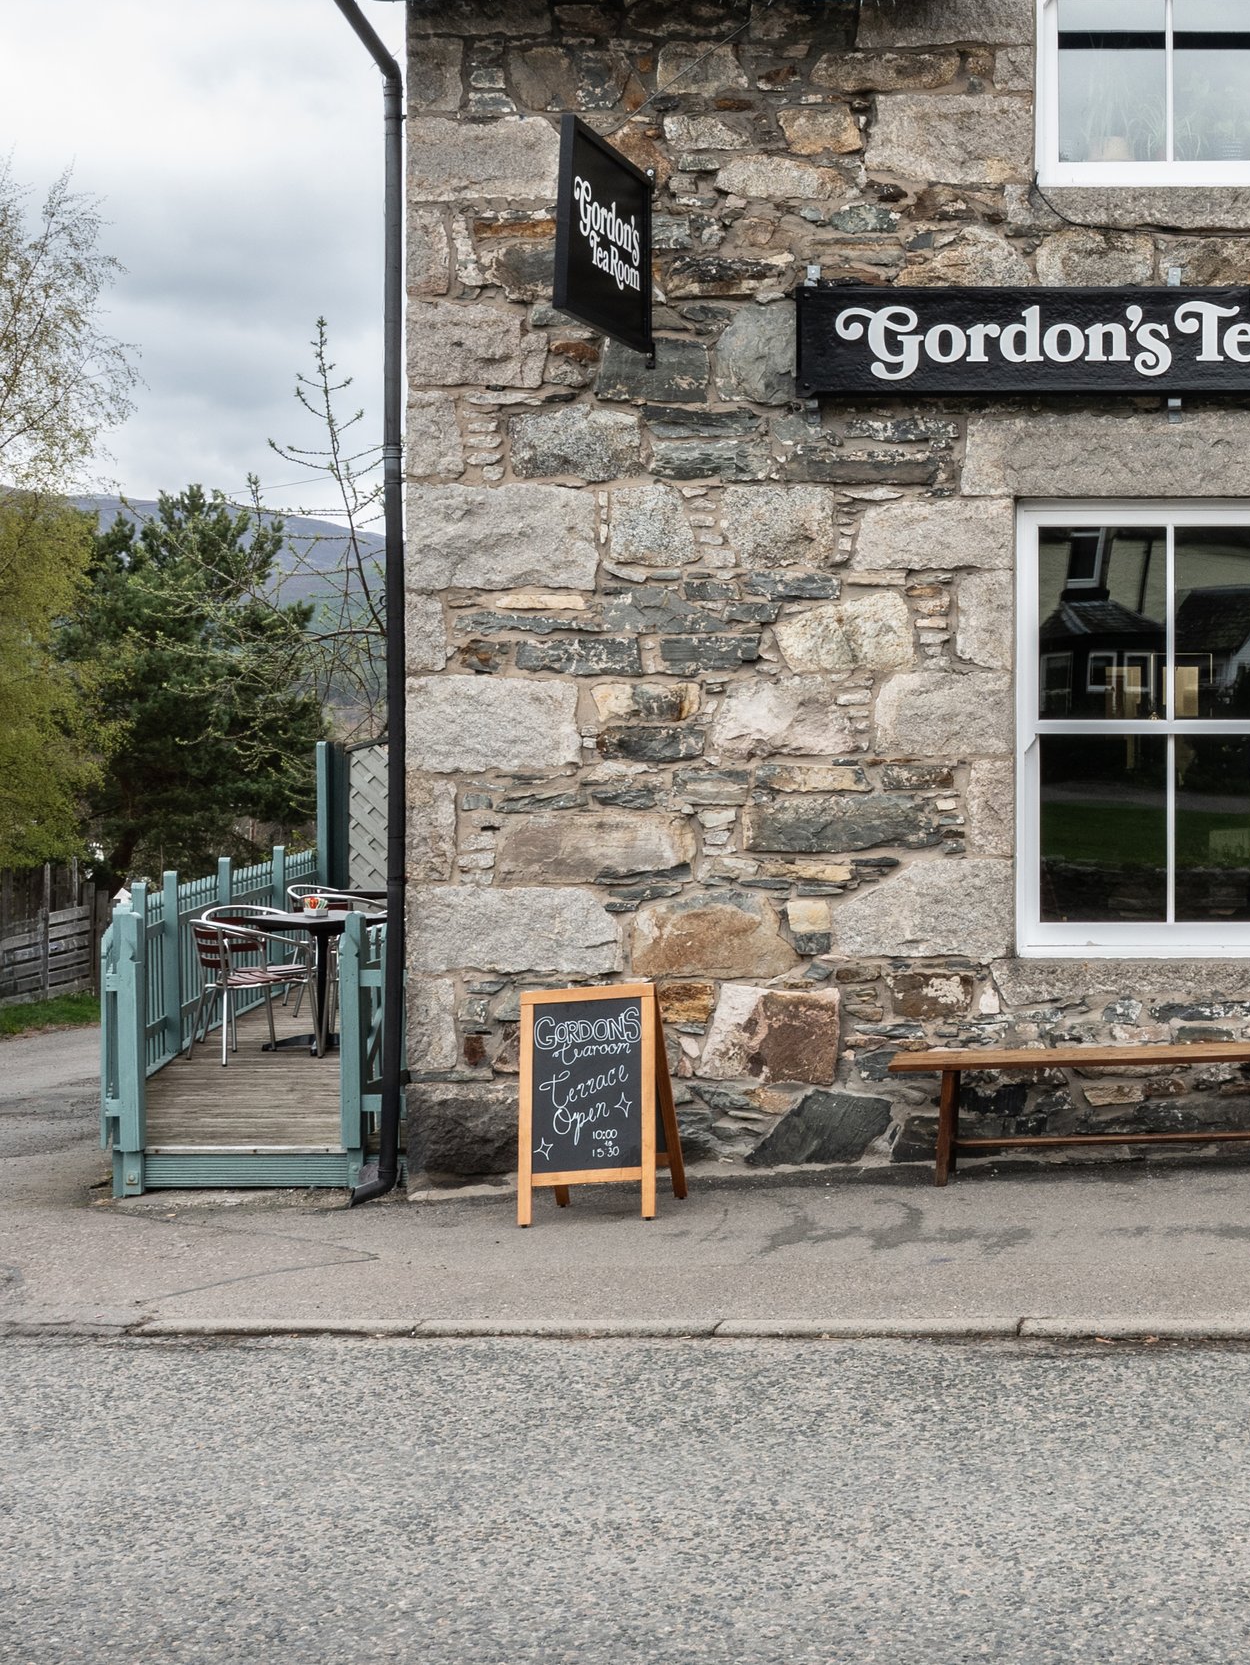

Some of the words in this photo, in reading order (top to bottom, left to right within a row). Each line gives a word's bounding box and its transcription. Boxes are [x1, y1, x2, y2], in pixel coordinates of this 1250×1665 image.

[574, 176, 640, 267] Gordon's
[589, 230, 610, 273] Tea
[610, 245, 641, 291] Room
[835, 304, 1173, 380] Gordon's
[552, 1042, 631, 1065] tearoom
[539, 1064, 629, 1109] Terrace
[552, 1101, 610, 1146] Open
[592, 1128, 618, 1140] 10:00
